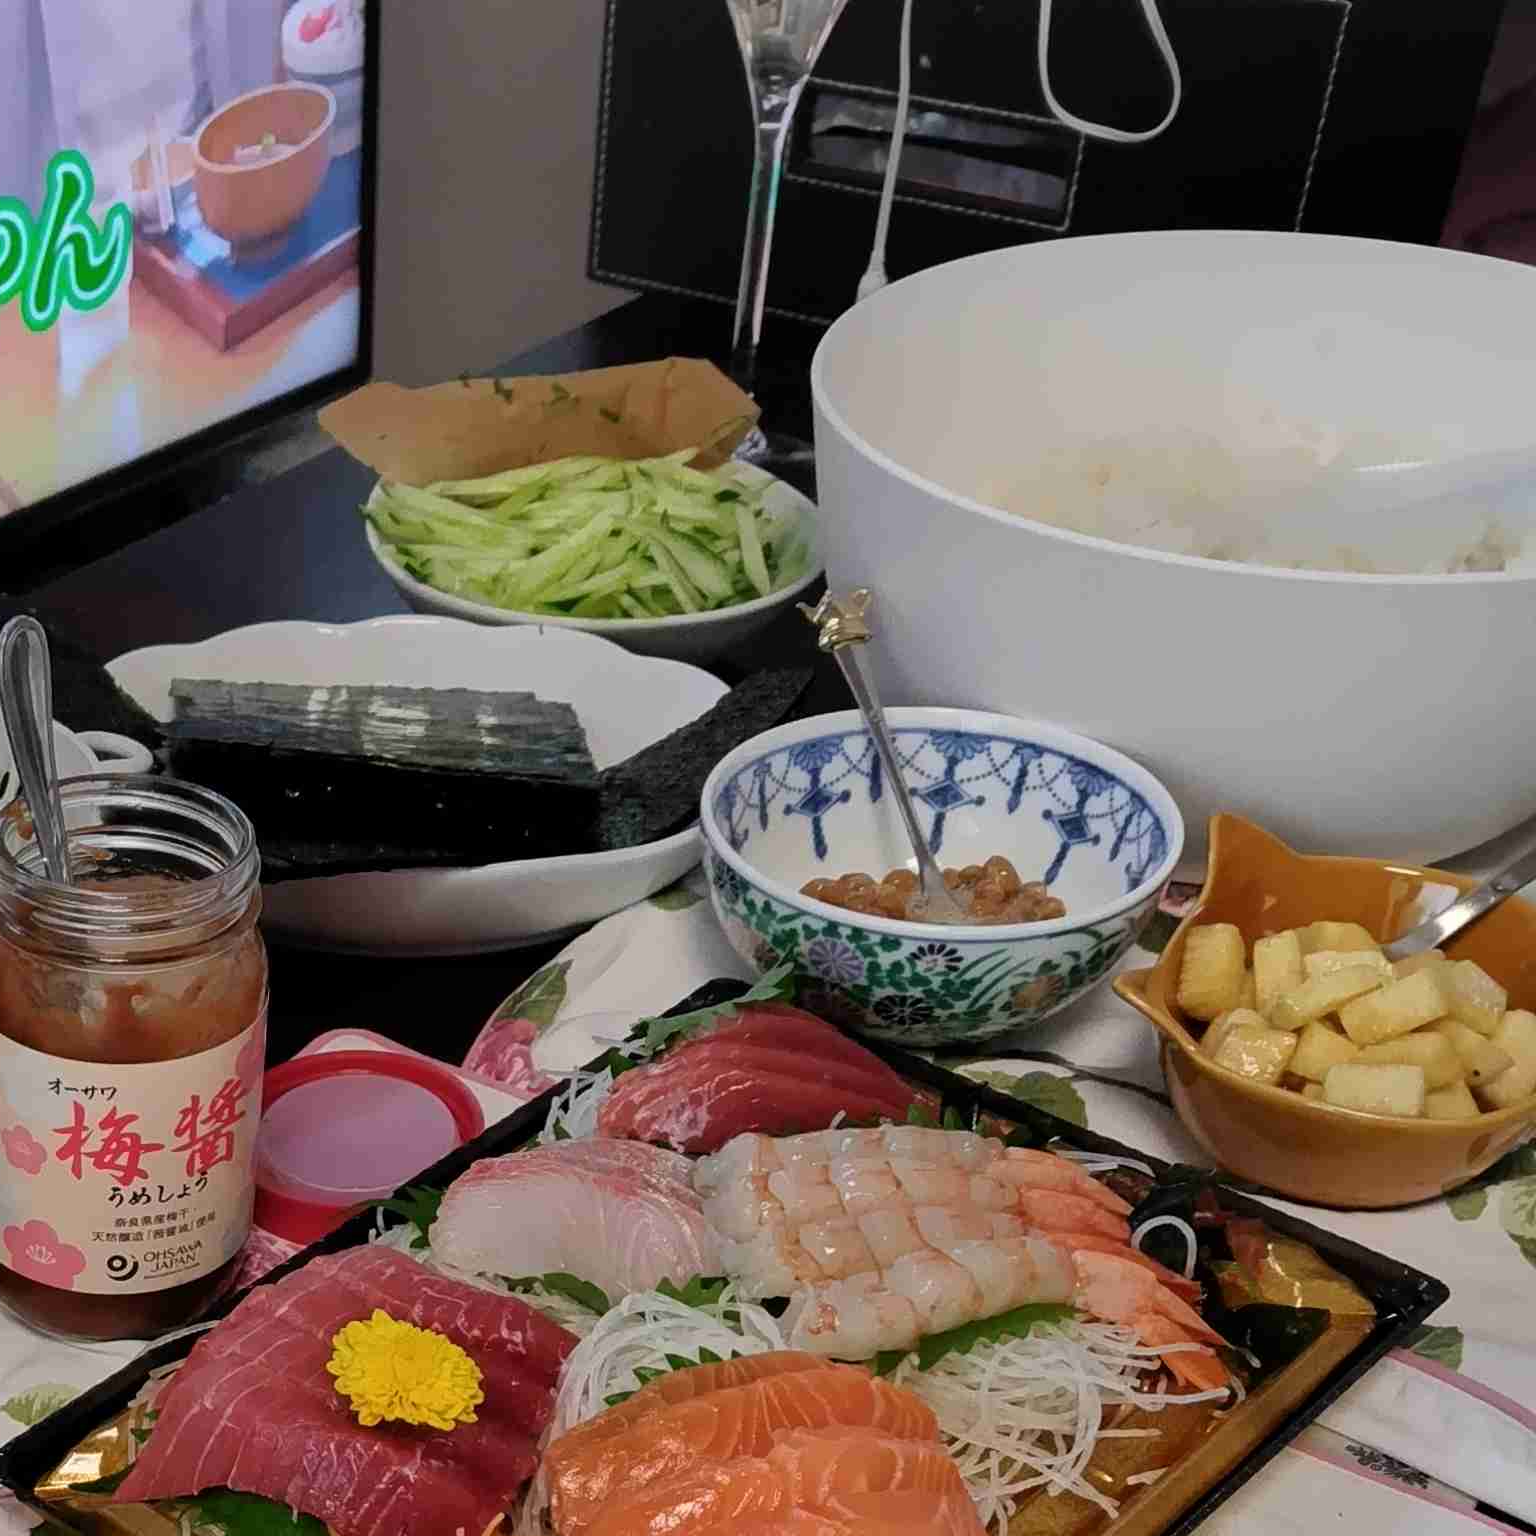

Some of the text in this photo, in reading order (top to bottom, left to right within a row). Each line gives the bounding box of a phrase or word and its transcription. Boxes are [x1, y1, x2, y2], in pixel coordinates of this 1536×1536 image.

[48, 1077, 117, 1101] オーサワ
[108, 1171, 208, 1208] うめしょう
[143, 1239, 203, 1262] OHSAWA
[150, 1253, 197, 1273] JAPAN
